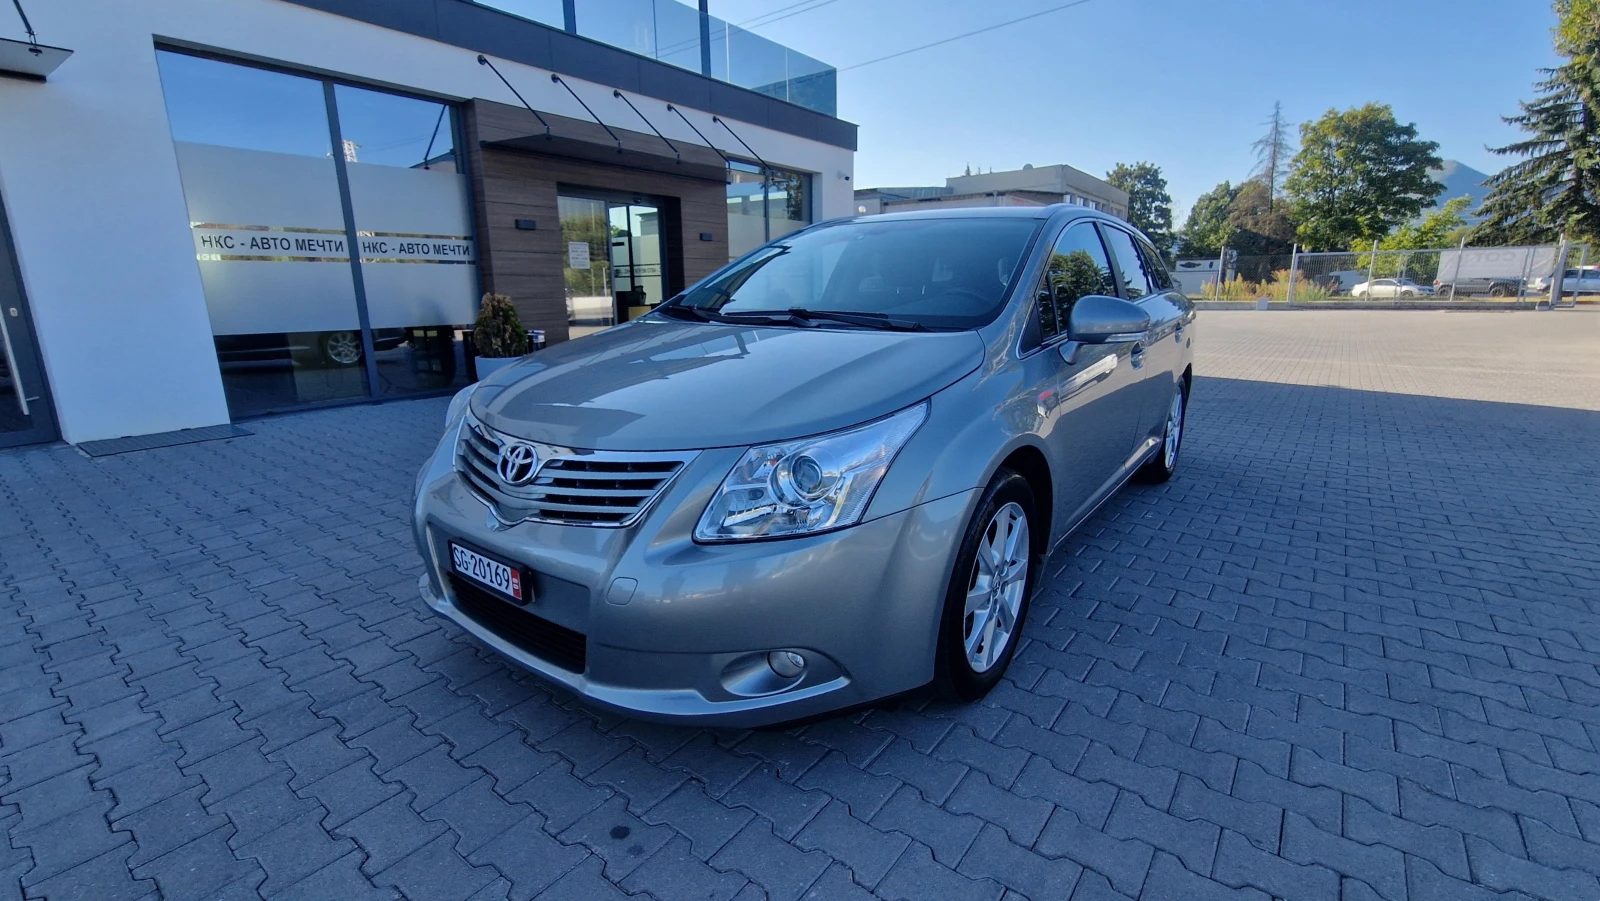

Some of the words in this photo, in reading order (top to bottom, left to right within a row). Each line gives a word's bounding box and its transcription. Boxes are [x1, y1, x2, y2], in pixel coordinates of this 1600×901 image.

[201, 235, 235, 249] НКС
[250, 236, 291, 251] АВТО
[295, 238, 344, 253] МЕЧТИ
[362, 241, 388, 254] НКС
[399, 242, 430, 255] АВТО
[433, 243, 470, 256] МЕЧТИ
